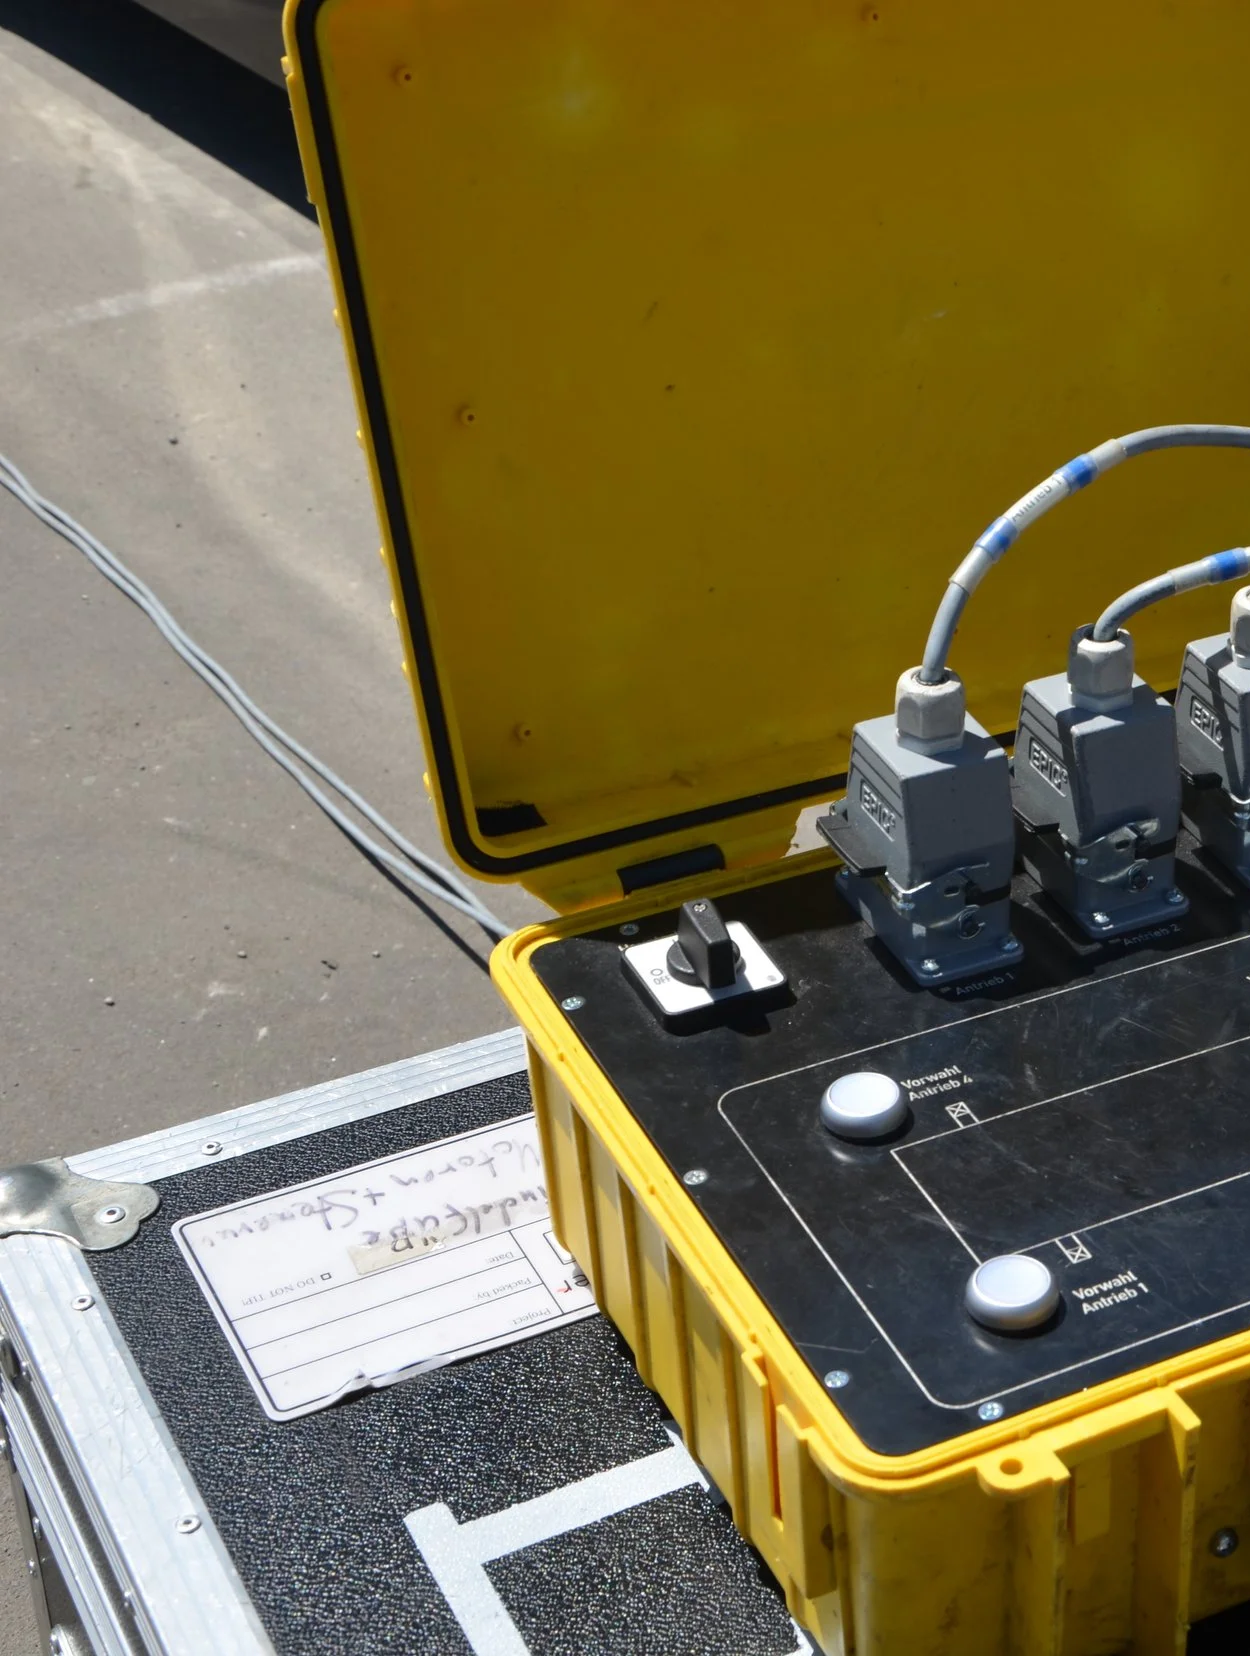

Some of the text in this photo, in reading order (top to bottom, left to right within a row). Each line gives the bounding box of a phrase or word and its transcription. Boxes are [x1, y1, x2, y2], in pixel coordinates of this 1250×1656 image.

[1122, 923, 1182, 947] Antrieb 2
[653, 975, 672, 986] OFF
[955, 971, 1016, 997] Antrieb 1
[900, 1064, 962, 1090] Vorwahl
[908, 1075, 973, 1102] Antrieb 4
[270, 1284, 295, 1298] NOT
[297, 1276, 316, 1290] DO
[492, 1277, 532, 1296] Packed
[1072, 1270, 1138, 1300] Vorwahl
[1081, 1282, 1149, 1316] Antrieb 1
